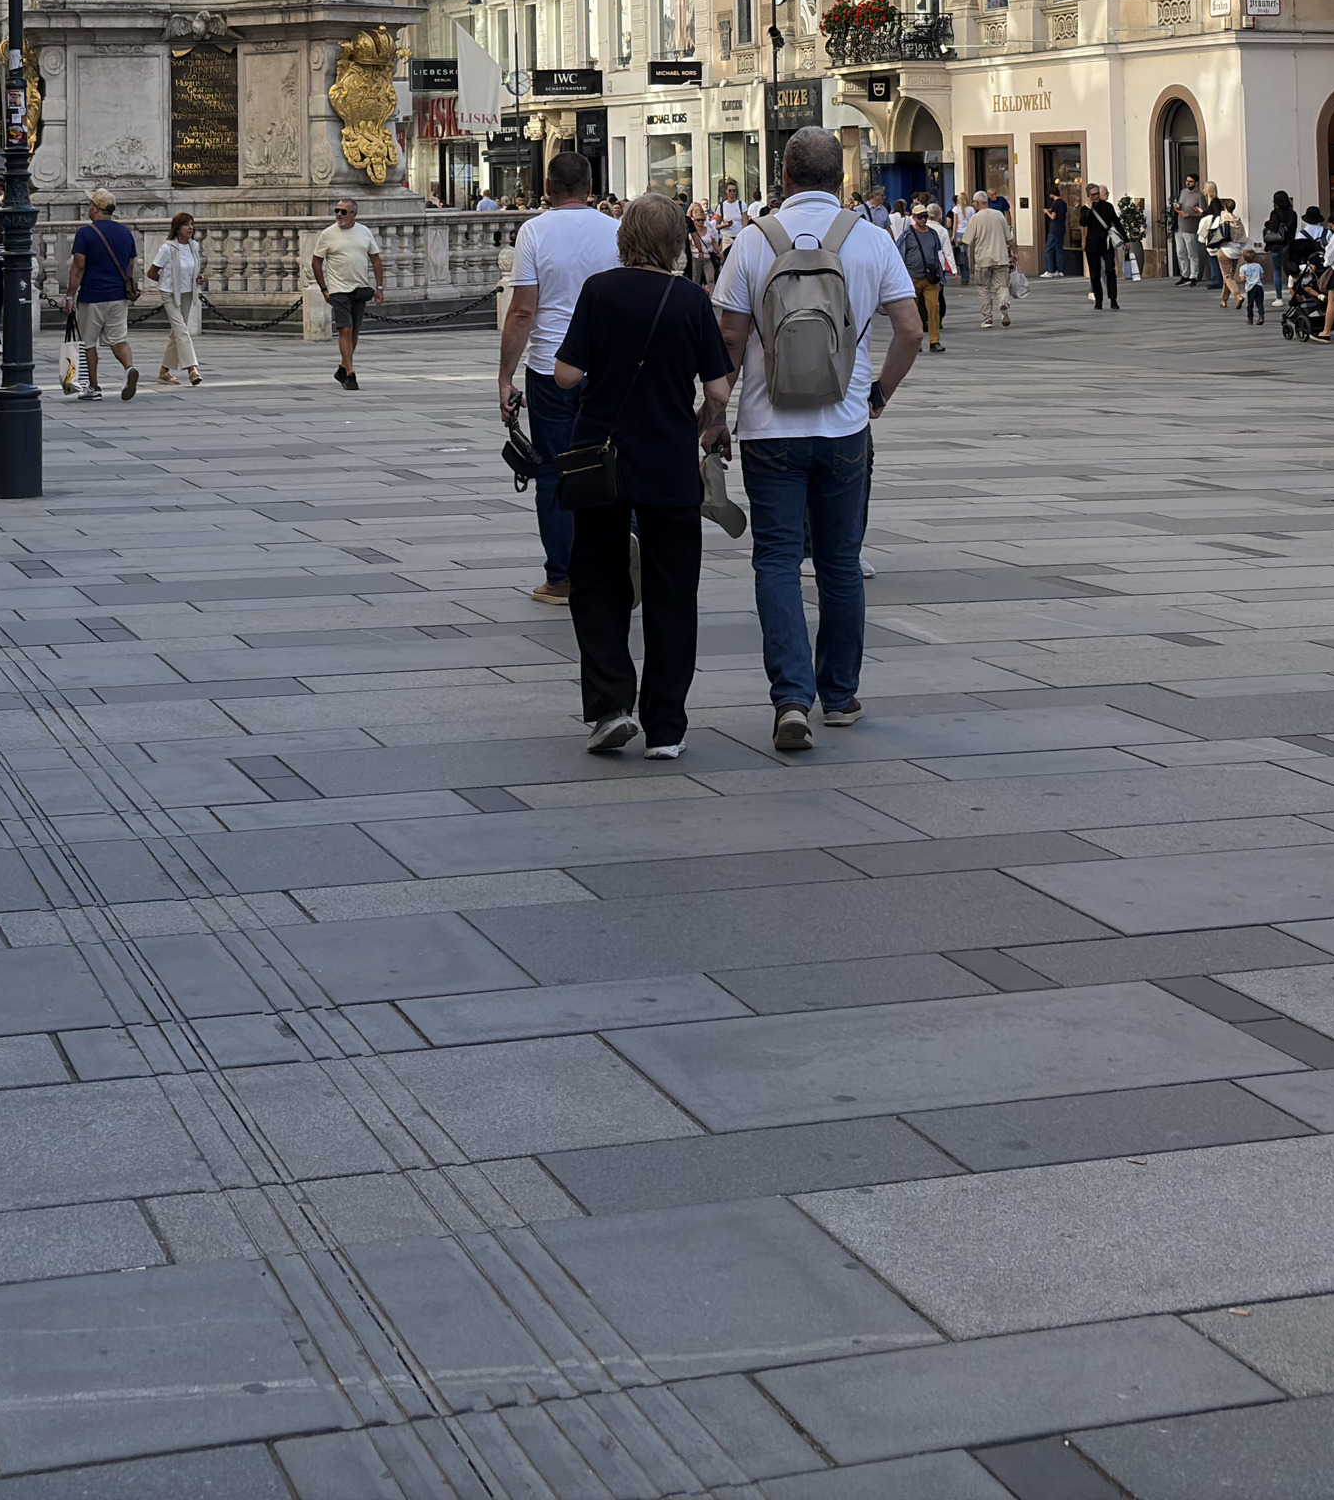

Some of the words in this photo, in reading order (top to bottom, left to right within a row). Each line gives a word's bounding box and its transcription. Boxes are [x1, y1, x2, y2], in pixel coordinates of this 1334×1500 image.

[413, 68, 458, 76] LIEBESKI
[554, 72, 578, 84] IWC
[992, 91, 1052, 112] HELDWEIN
[417, 96, 470, 139] LISK
[460, 113, 499, 125] LISKA
